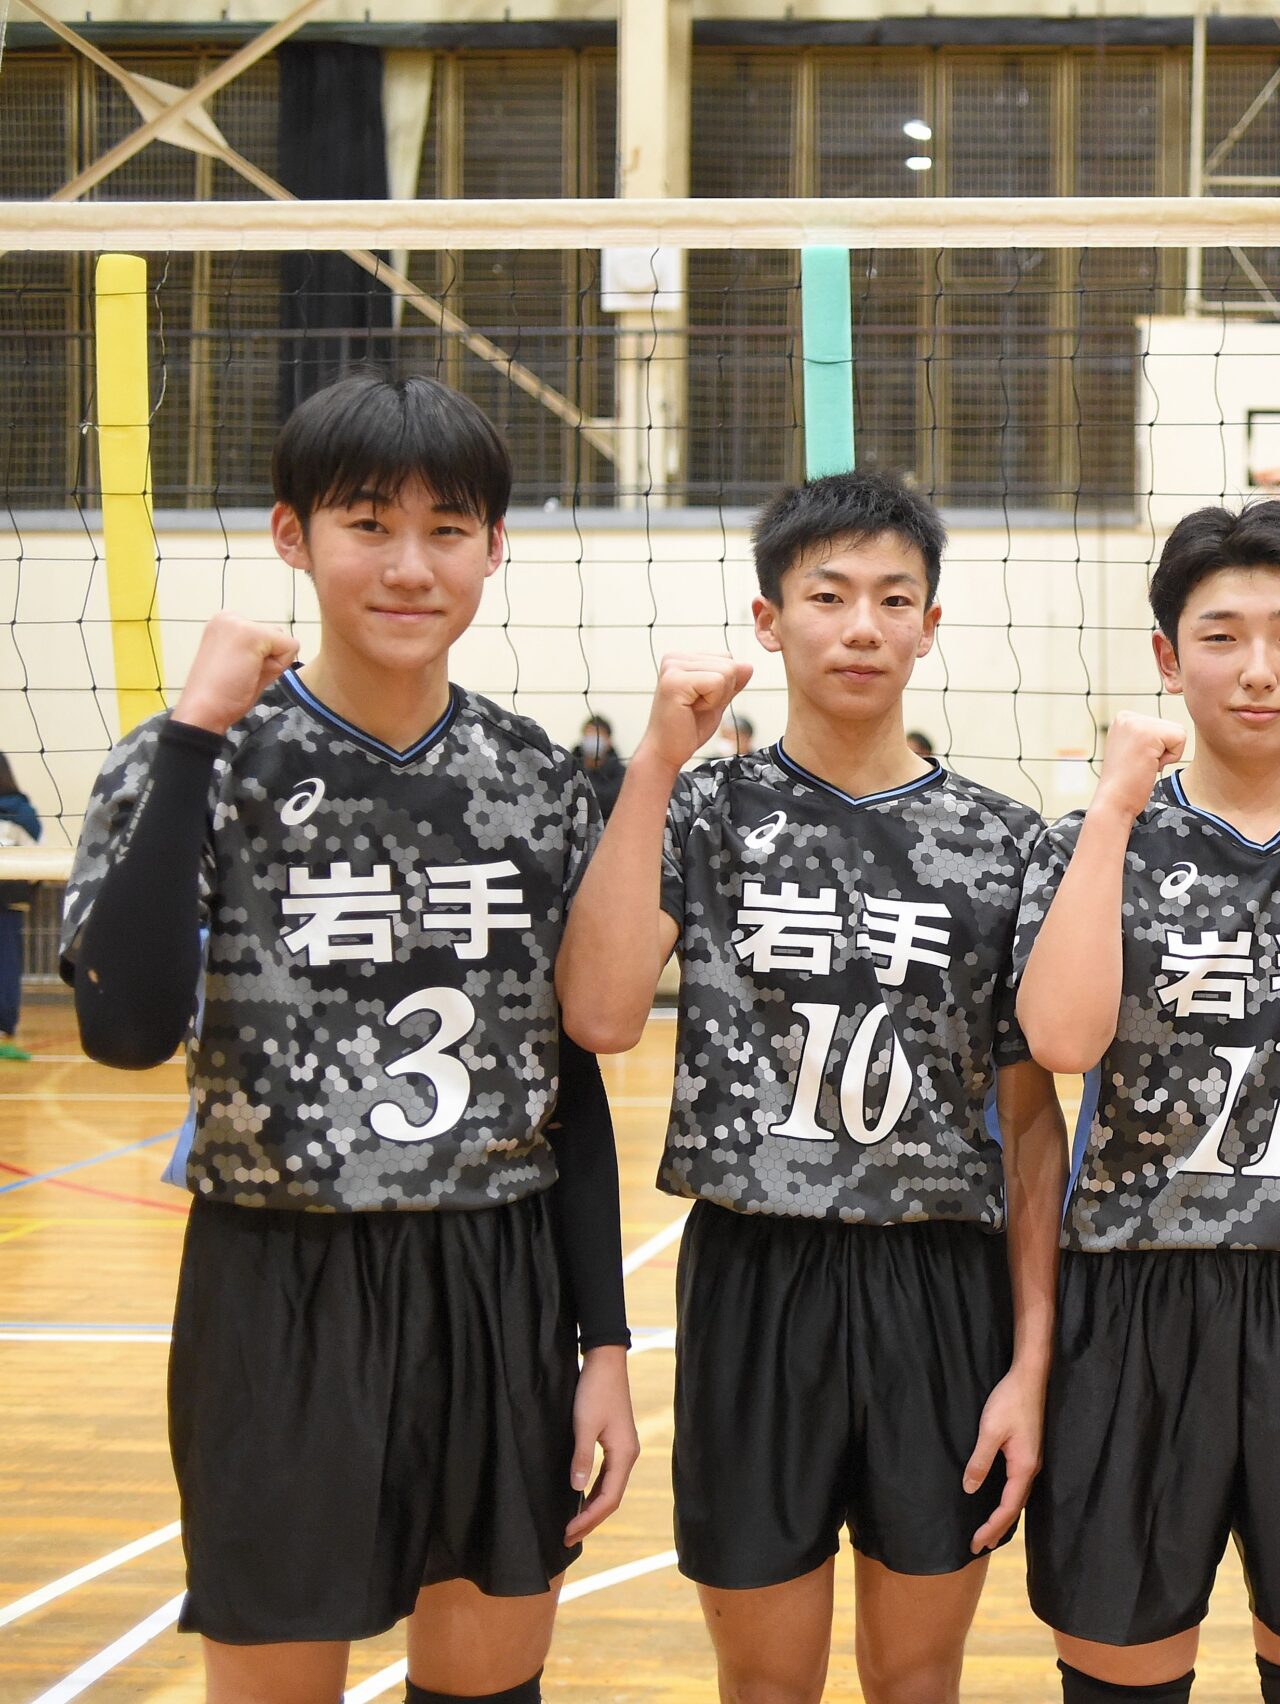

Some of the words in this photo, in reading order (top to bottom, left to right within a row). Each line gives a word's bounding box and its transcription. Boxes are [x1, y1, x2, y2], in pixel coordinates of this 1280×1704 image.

[280, 860, 532, 966] 岩手
[734, 880, 953, 986] 岩手
[369, 986, 477, 1142] 3
[768, 1001, 913, 1145] 10
